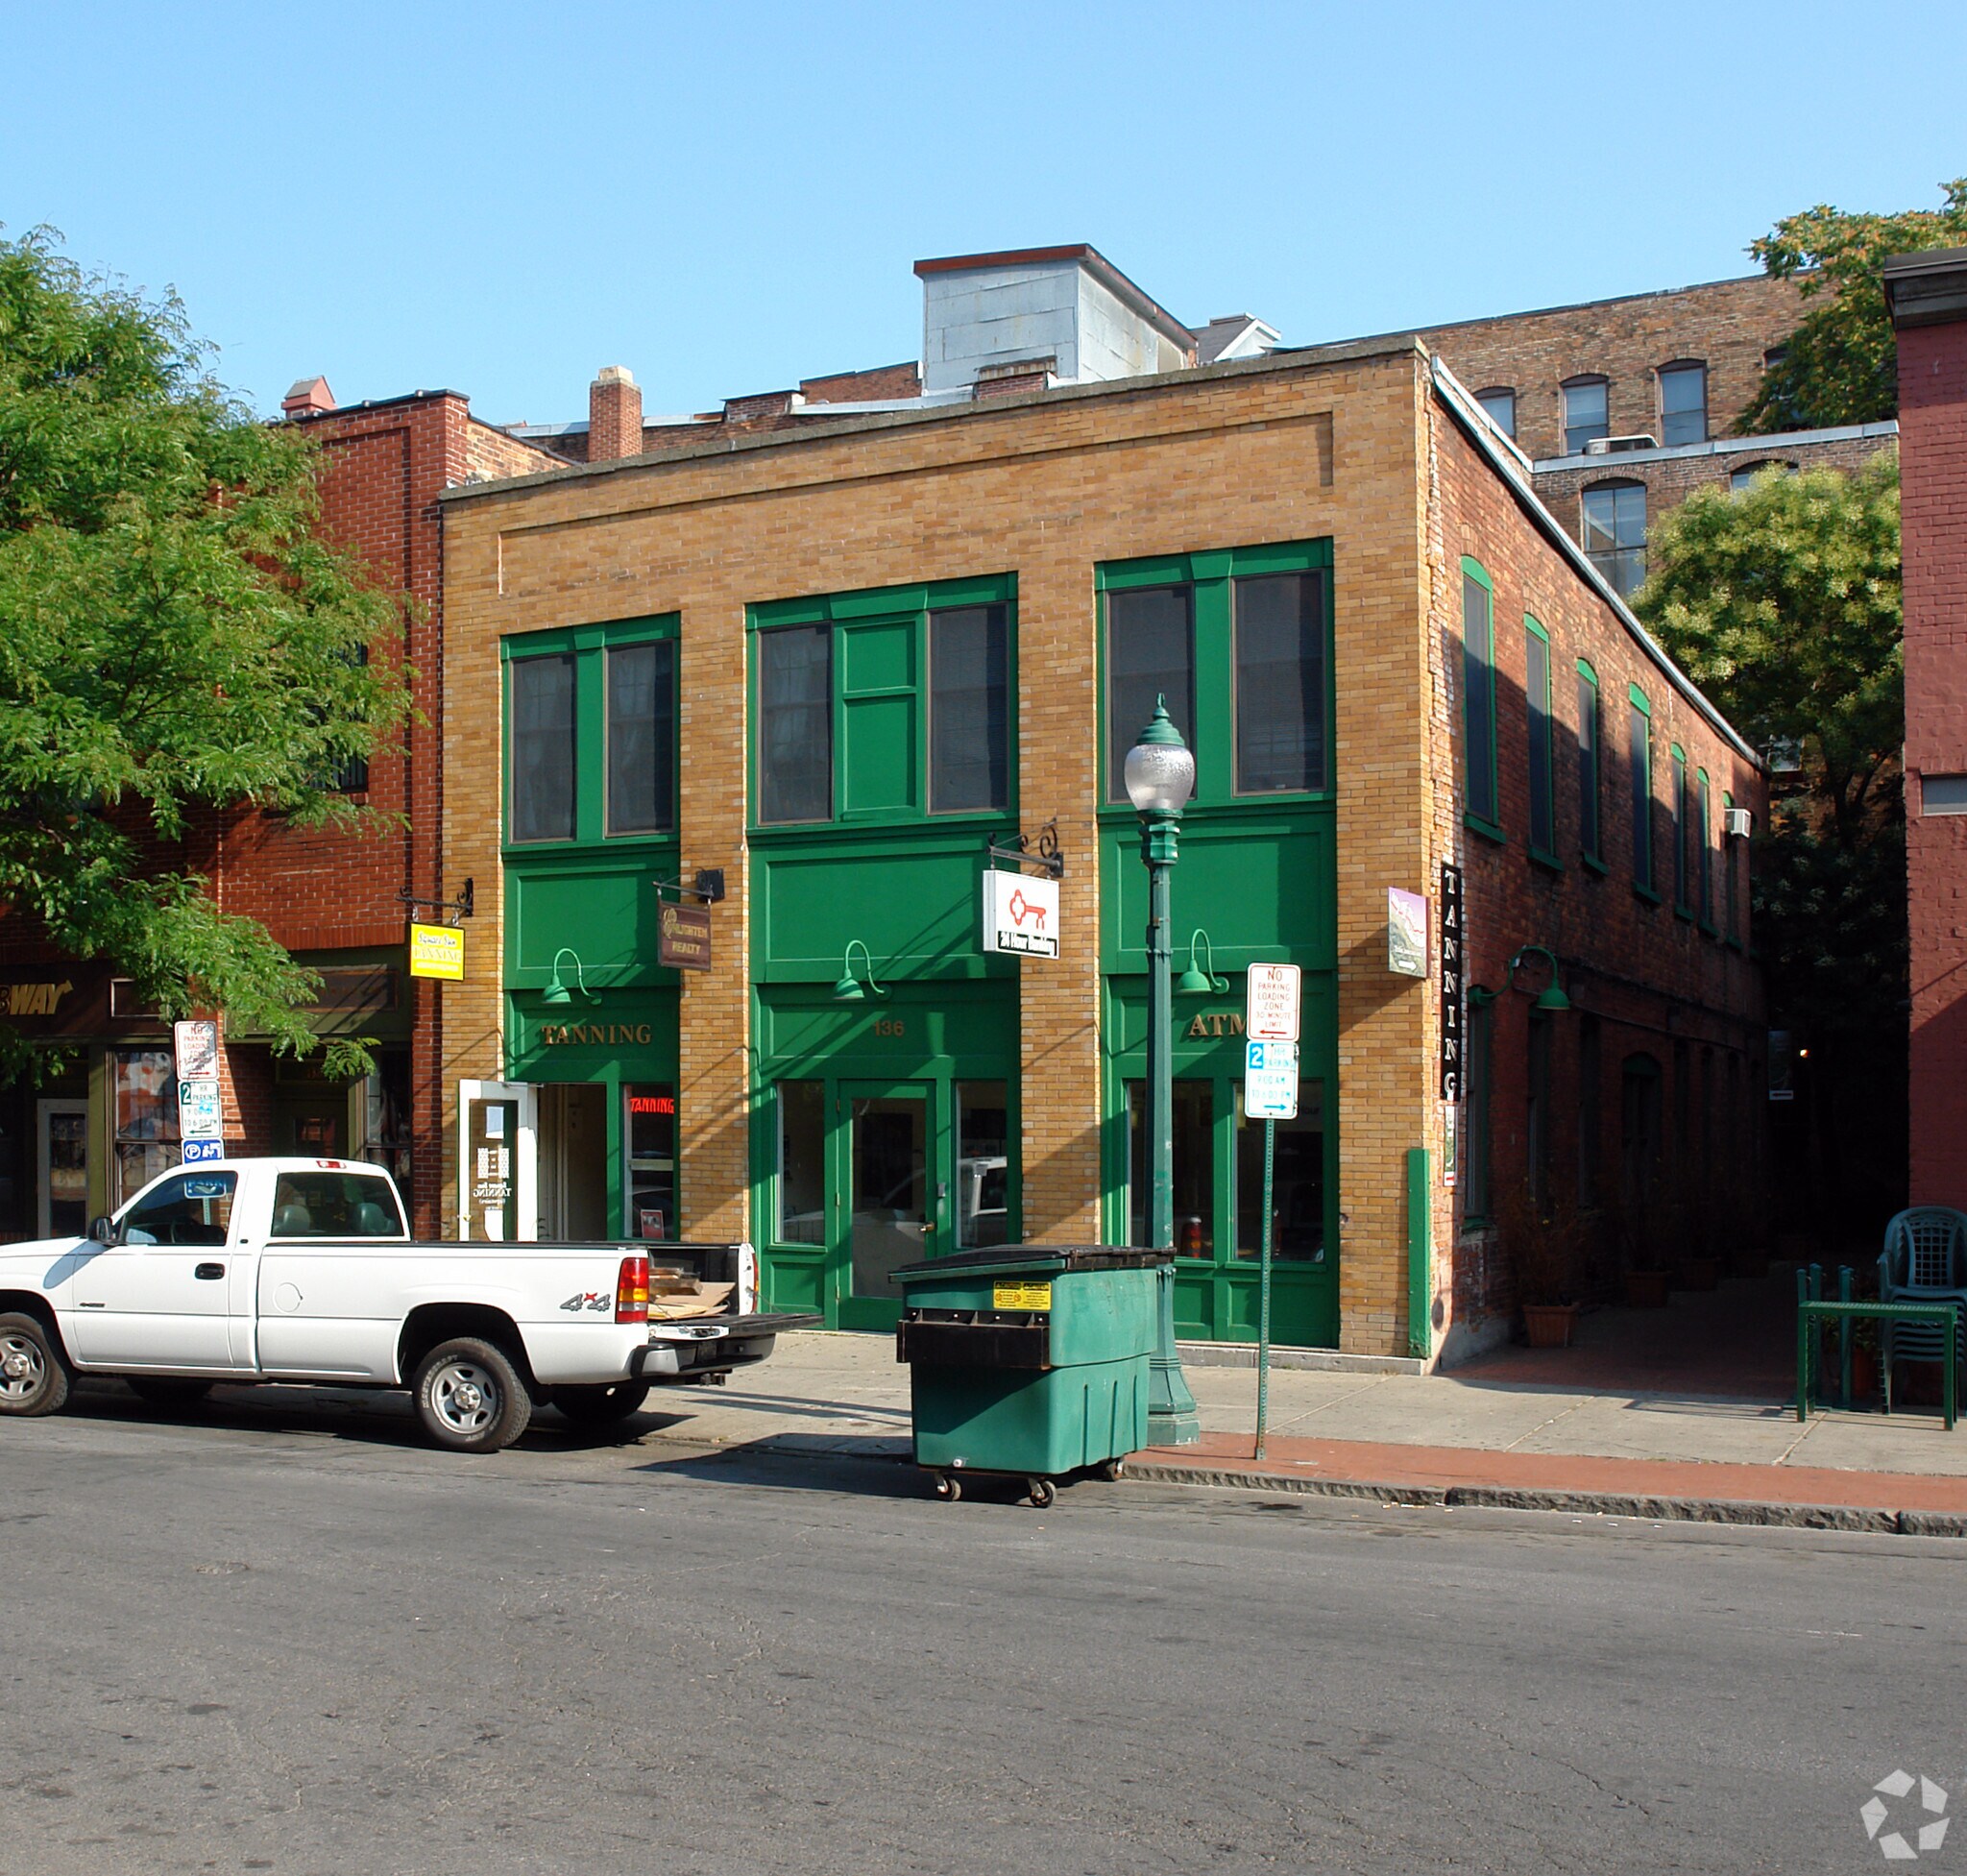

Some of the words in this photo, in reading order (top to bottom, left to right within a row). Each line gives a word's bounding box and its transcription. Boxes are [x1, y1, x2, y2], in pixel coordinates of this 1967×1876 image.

[411, 945, 462, 962] TANNING
[672, 940, 701, 956] REALTY
[1267, 969, 1283, 982] NO
[1257, 982, 1291, 992] PARKING
[1443, 868, 1458, 1100] TANNING
[1257, 992, 1291, 1001] LOADING
[1264, 1002, 1284, 1011] ZONE
[1267, 1011, 1291, 1020] MINUTE
[190, 1025, 203, 1035] NO
[873, 1020, 905, 1037] 136
[1187, 1013, 1248, 1036] ATM
[541, 1024, 652, 1045] TANNING
[1251, 1046, 1263, 1066] 2
[1274, 1047, 1285, 1056] HR
[1275, 1076, 1286, 1084] AM
[182, 1084, 191, 1104] 2
[629, 1097, 674, 1114] TANNING
